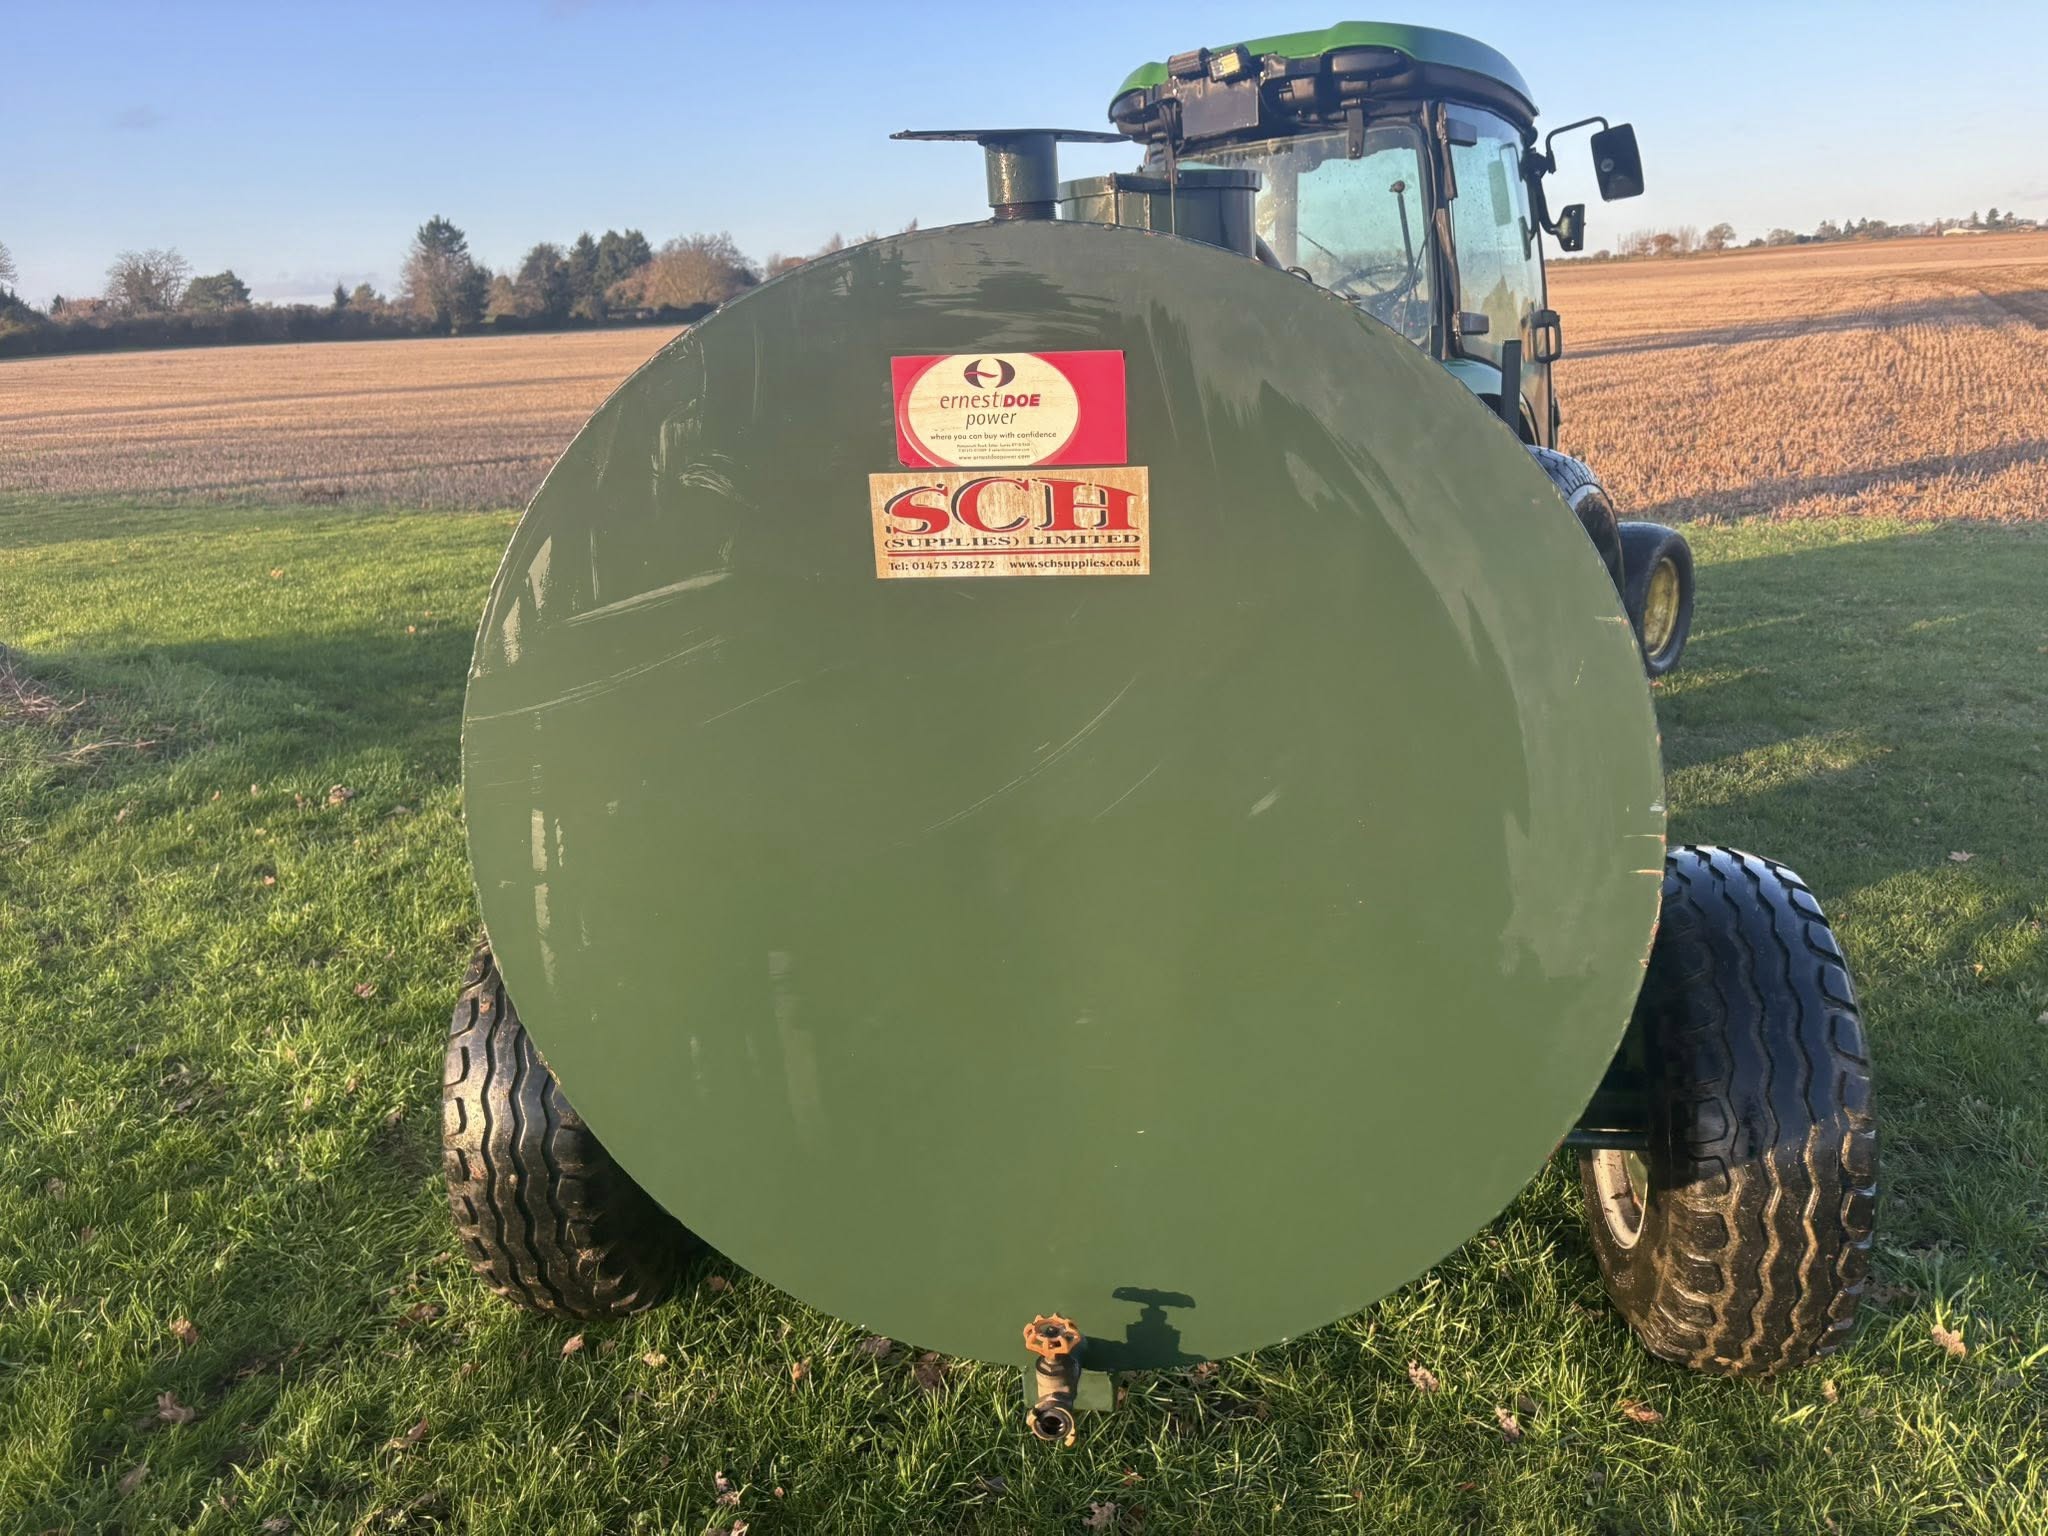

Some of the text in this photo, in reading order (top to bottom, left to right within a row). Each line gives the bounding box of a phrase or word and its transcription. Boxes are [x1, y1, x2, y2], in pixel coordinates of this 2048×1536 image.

[939, 391, 1041, 409] ernest DOE
[965, 412, 1017, 430] power
[953, 434, 967, 442] you
[1017, 431, 1057, 439] confidence
[884, 476, 1140, 535] SCH
[884, 534, 1141, 549] (SUPPLIES) LIMITED
[888, 557, 1141, 571] Tel: 01473 328272 www.schsupplies.co.uk
